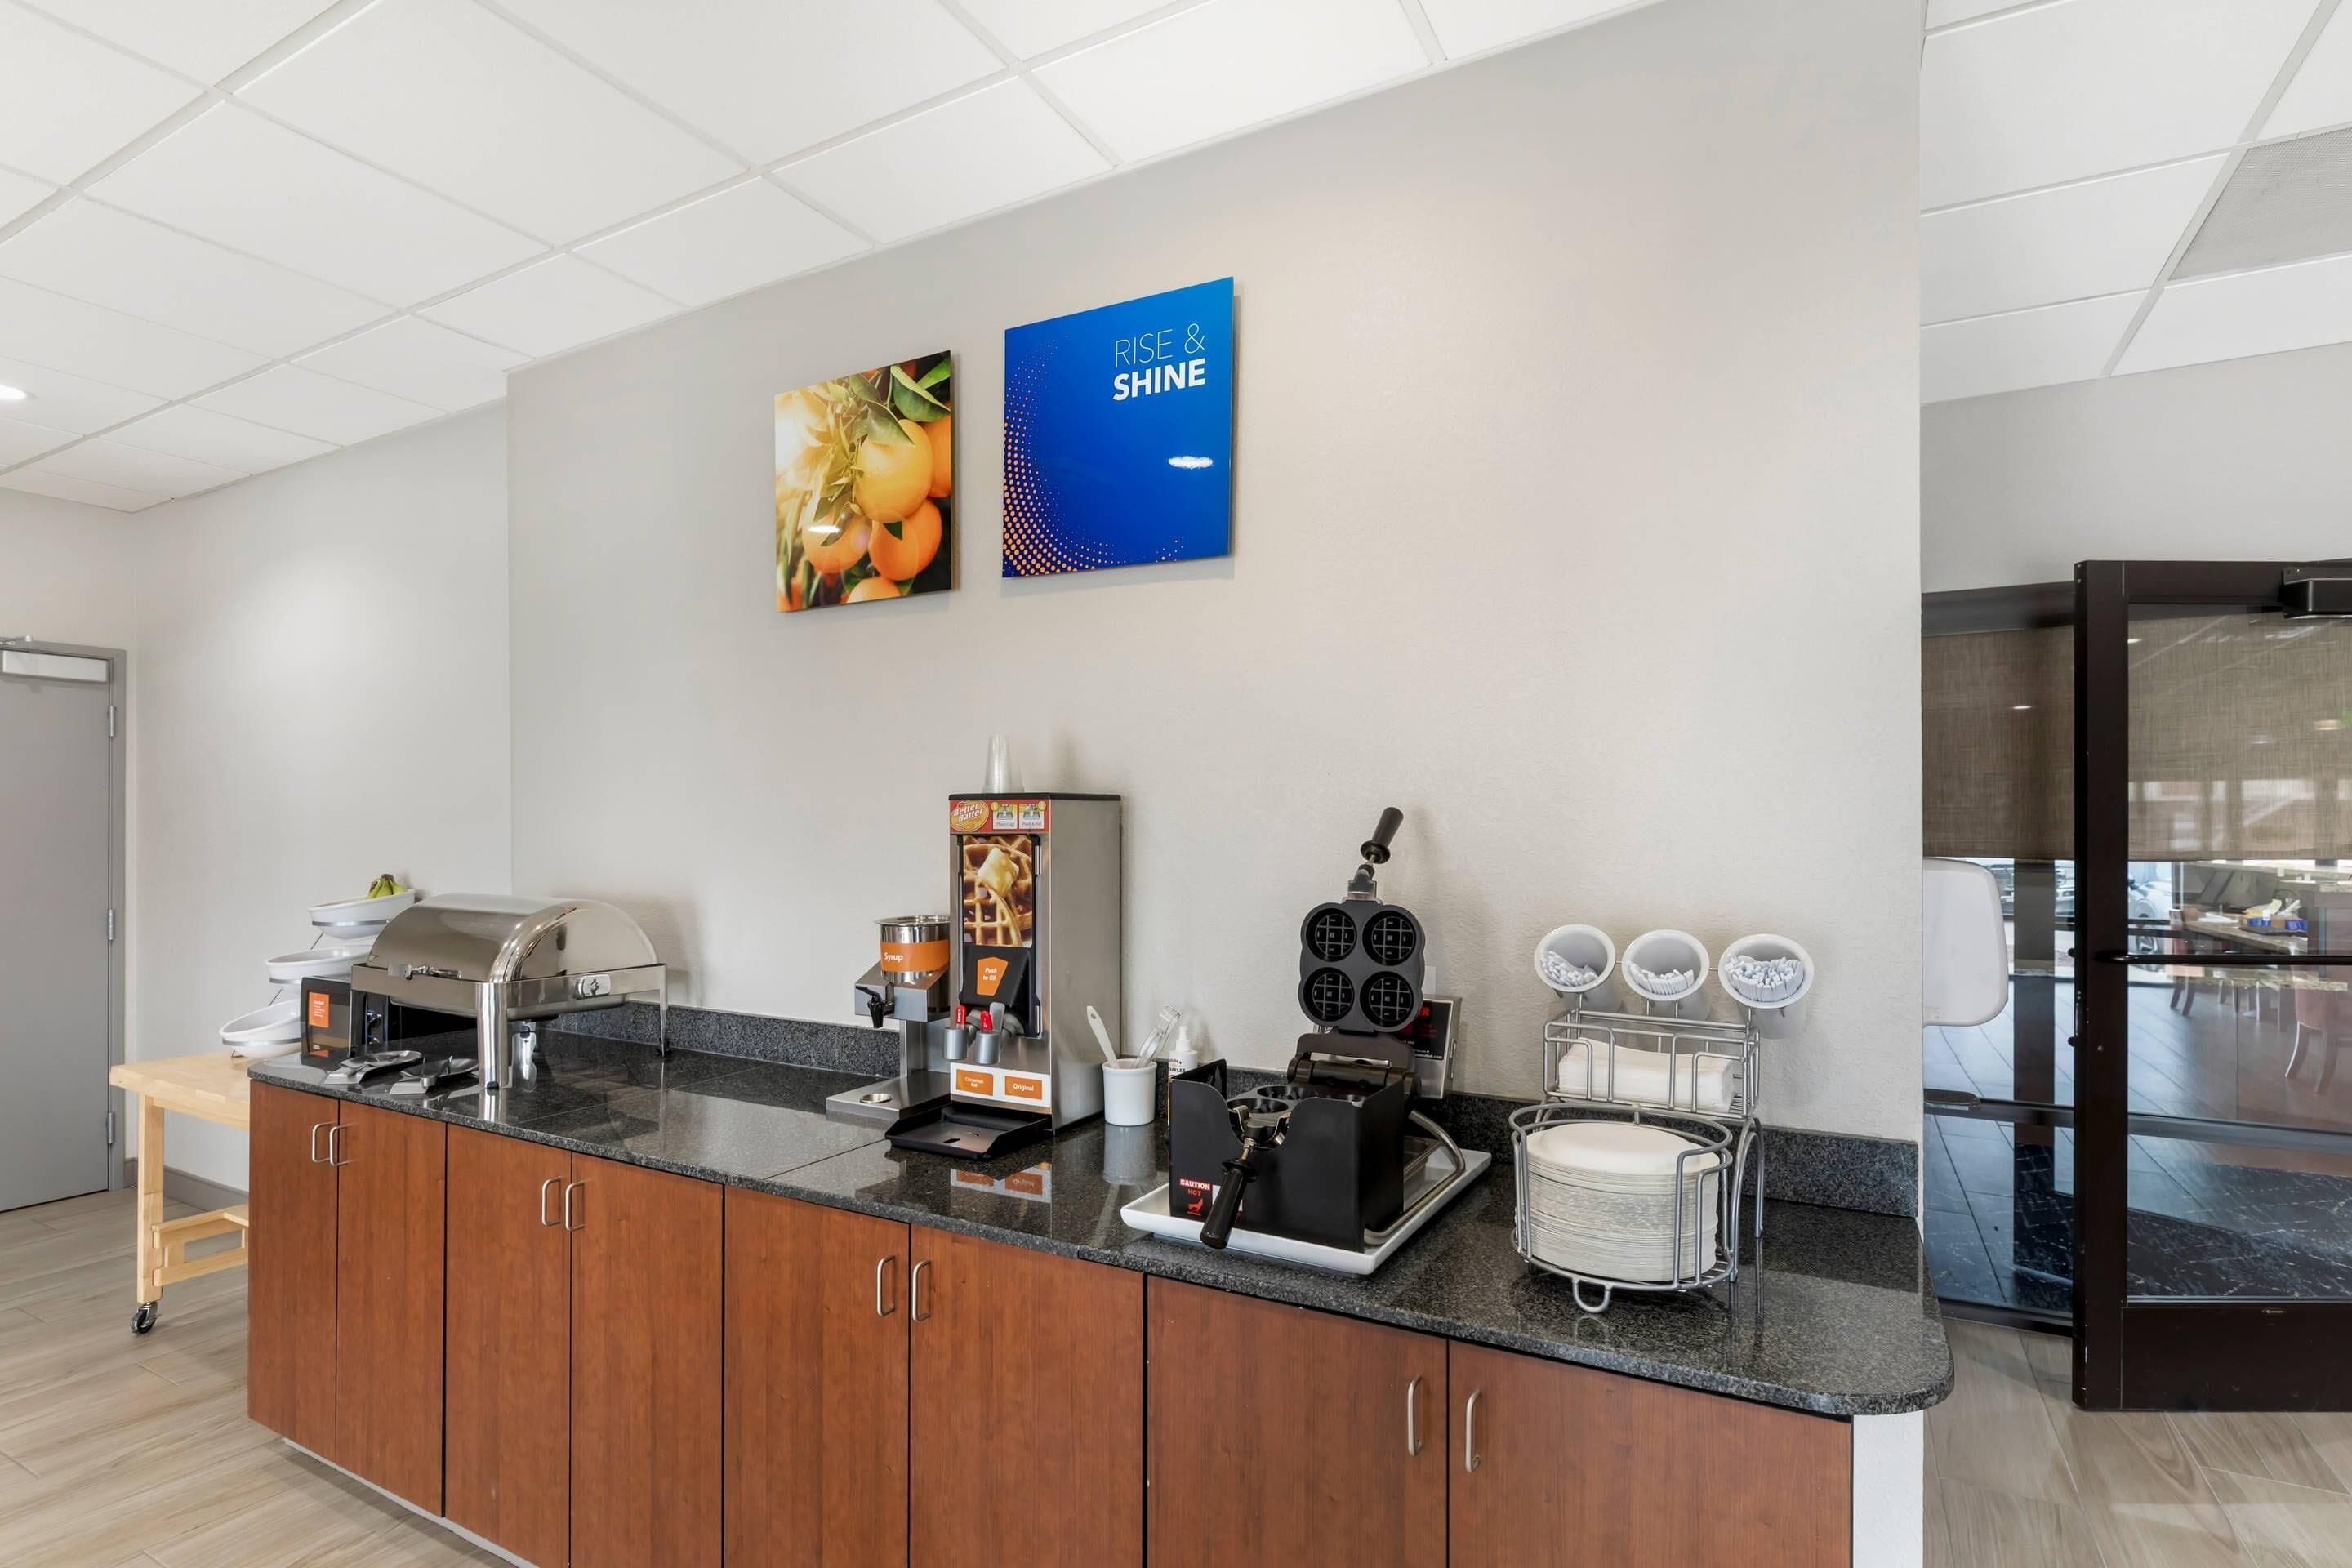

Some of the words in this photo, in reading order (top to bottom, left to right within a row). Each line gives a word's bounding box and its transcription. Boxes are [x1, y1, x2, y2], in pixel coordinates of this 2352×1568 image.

[1115, 328, 1173, 368] RISE
[1184, 323, 1205, 354] &
[1113, 358, 1206, 401] SHINE
[953, 803, 978, 816] Better
[958, 808, 982, 822] Batter
[884, 952, 903, 962] Syrup
[1013, 1083, 1035, 1092] Original
[1180, 1178, 1210, 1191] CAUTION
[1187, 1188, 1202, 1196] HOT
